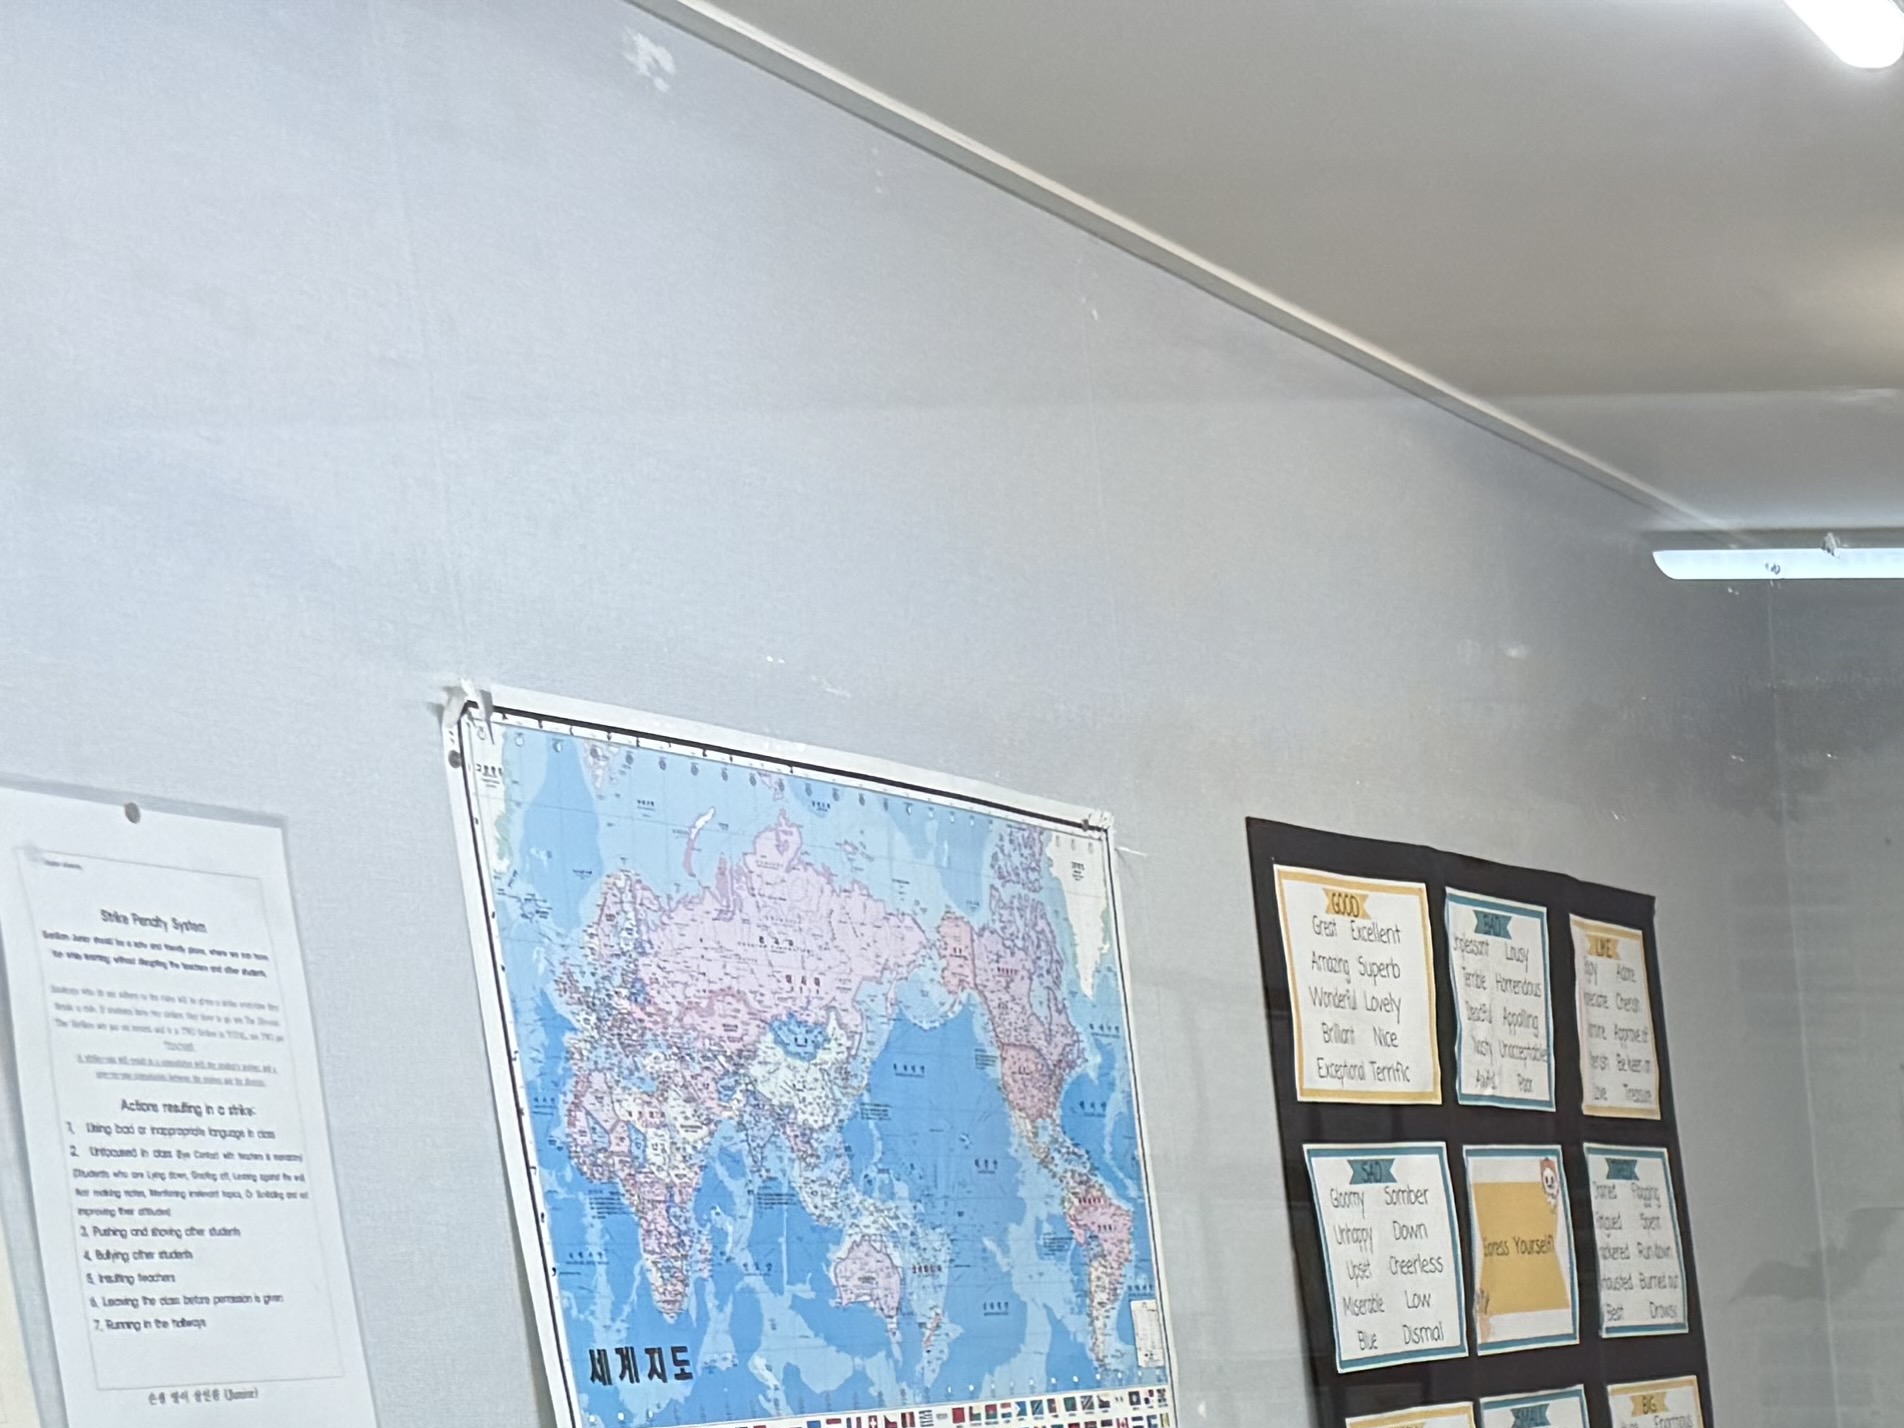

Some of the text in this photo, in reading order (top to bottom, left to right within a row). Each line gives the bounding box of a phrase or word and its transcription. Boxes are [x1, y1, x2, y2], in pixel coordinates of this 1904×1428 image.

[1351, 920, 1400, 944] Excellent
[1358, 956, 1400, 986] Superb
[1364, 991, 1400, 1024] Lovely
[1373, 1027, 1398, 1047] Nice
[1384, 1184, 1428, 1206] Somber
[1393, 1220, 1427, 1241] Down
[1405, 1290, 1431, 1308] Low
[1403, 1322, 1443, 1345] Dismal
[589, 1345, 694, 1386] 세계지도
